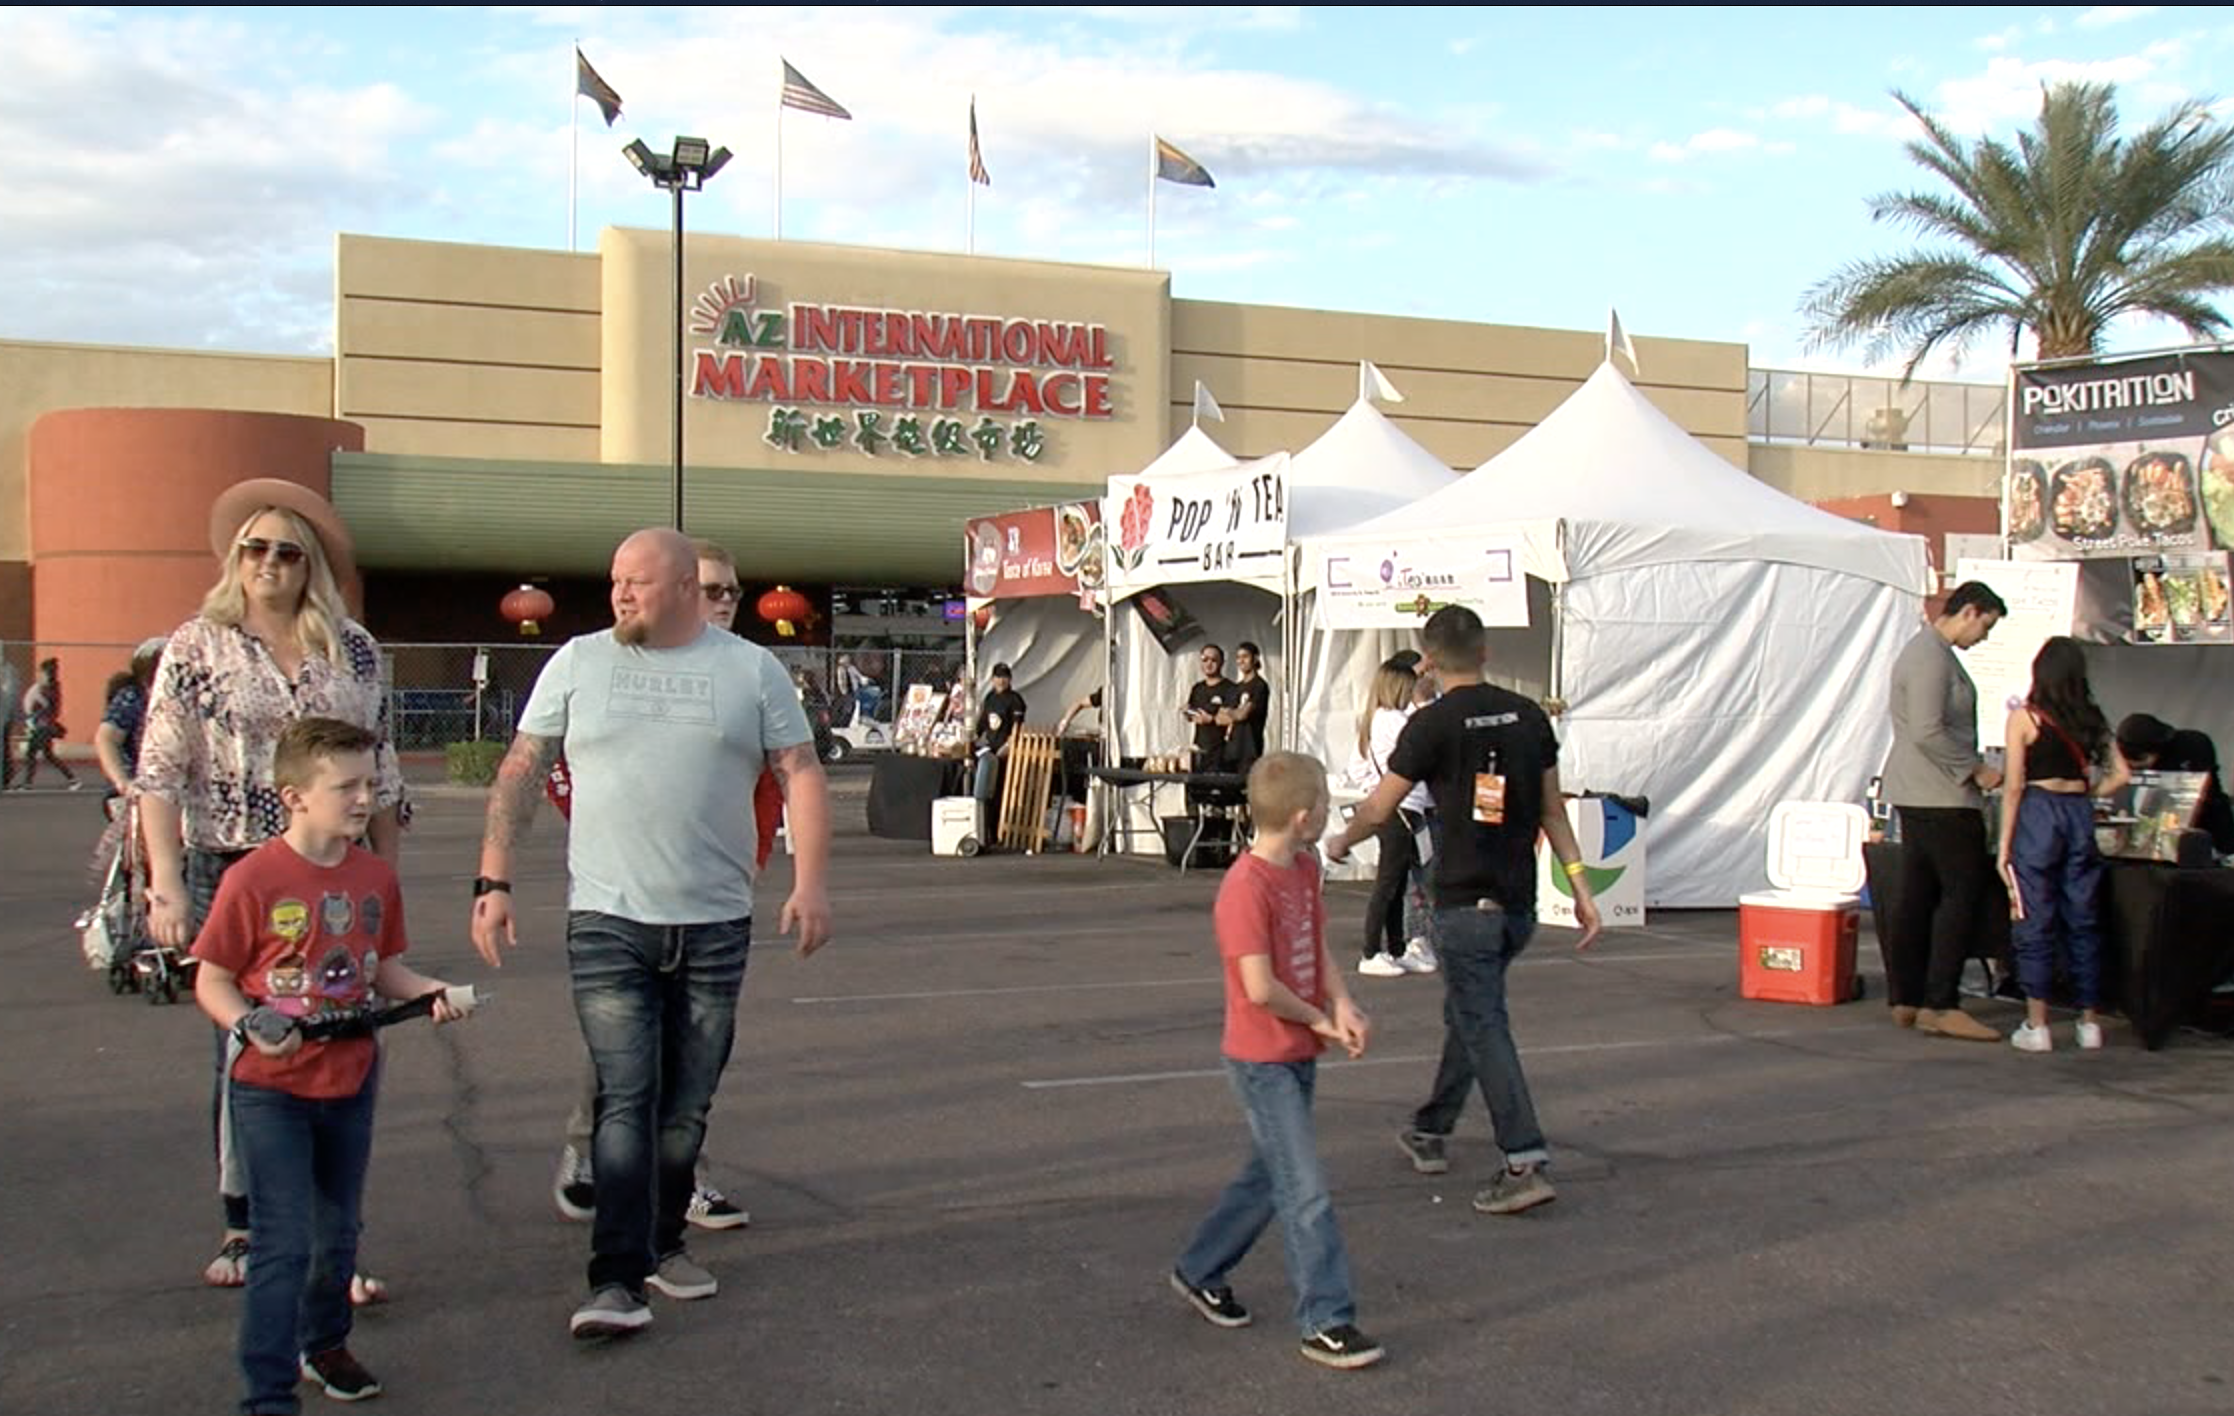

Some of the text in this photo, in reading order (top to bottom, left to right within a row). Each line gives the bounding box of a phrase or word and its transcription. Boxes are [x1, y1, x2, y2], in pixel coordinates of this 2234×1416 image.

[718, 303, 1114, 368] AZ INTERNATIONAL
[690, 350, 1114, 417] MARKETPLACE
[2024, 372, 2195, 415] POKITRITION
[1167, 496, 1212, 542] POP
[1252, 473, 1284, 523] TEA
[1203, 542, 1235, 572] BAR
[2073, 530, 2195, 551] Street Poke Tacos
[613, 670, 710, 696] HURLEY
